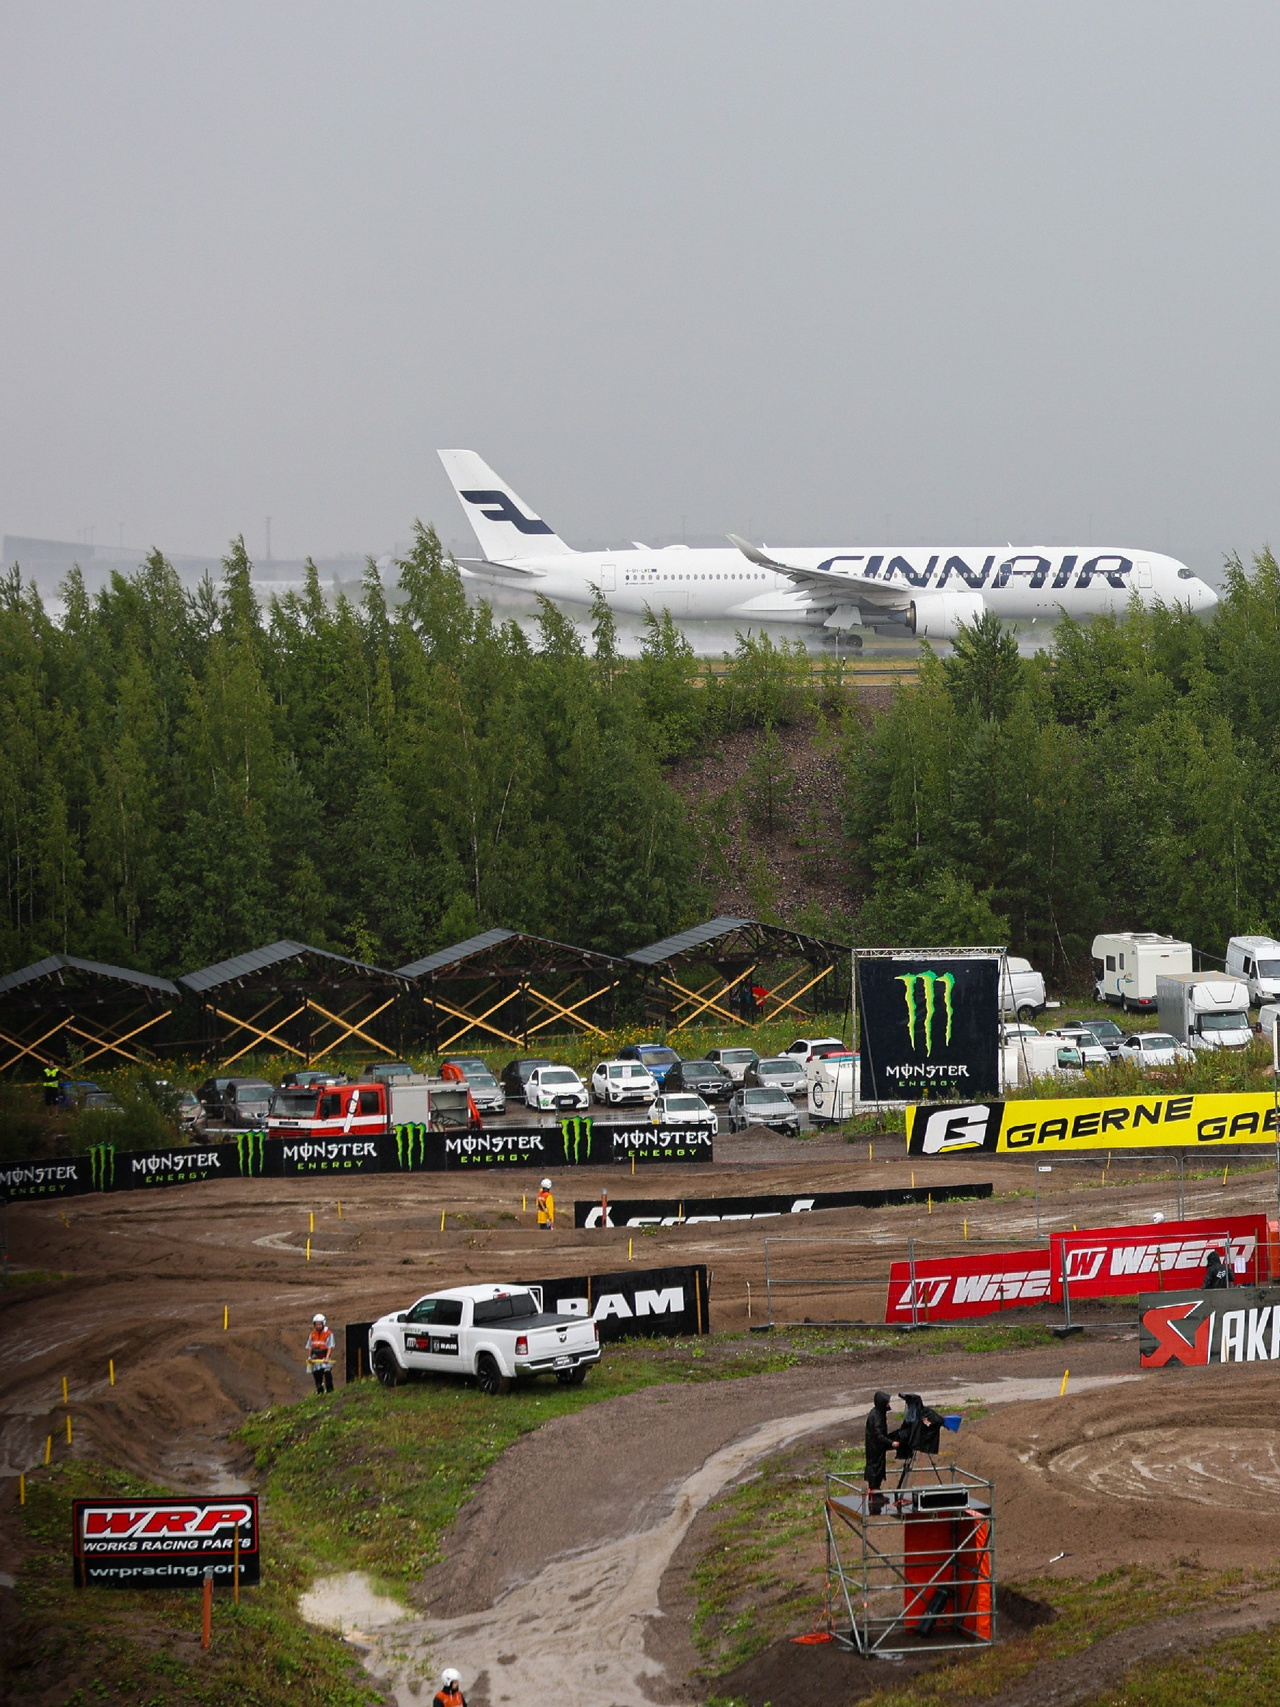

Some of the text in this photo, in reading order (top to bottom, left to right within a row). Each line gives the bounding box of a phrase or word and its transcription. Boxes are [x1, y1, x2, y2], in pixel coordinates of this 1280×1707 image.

[816, 555, 1133, 589] FINNAIR
[1006, 1096, 1194, 1148] GAERNE
[460, 1153, 530, 1163] ENERGY
[628, 1148, 697, 1157] ENERGY
[297, 1160, 364, 1170] ENERGY
[146, 1171, 208, 1183] ENERGY
[10, 1184, 66, 1195] ENERGY
[556, 1287, 685, 1321] RAM
[84, 1541, 137, 1552] WORKS
[142, 1540, 199, 1551] RACING
